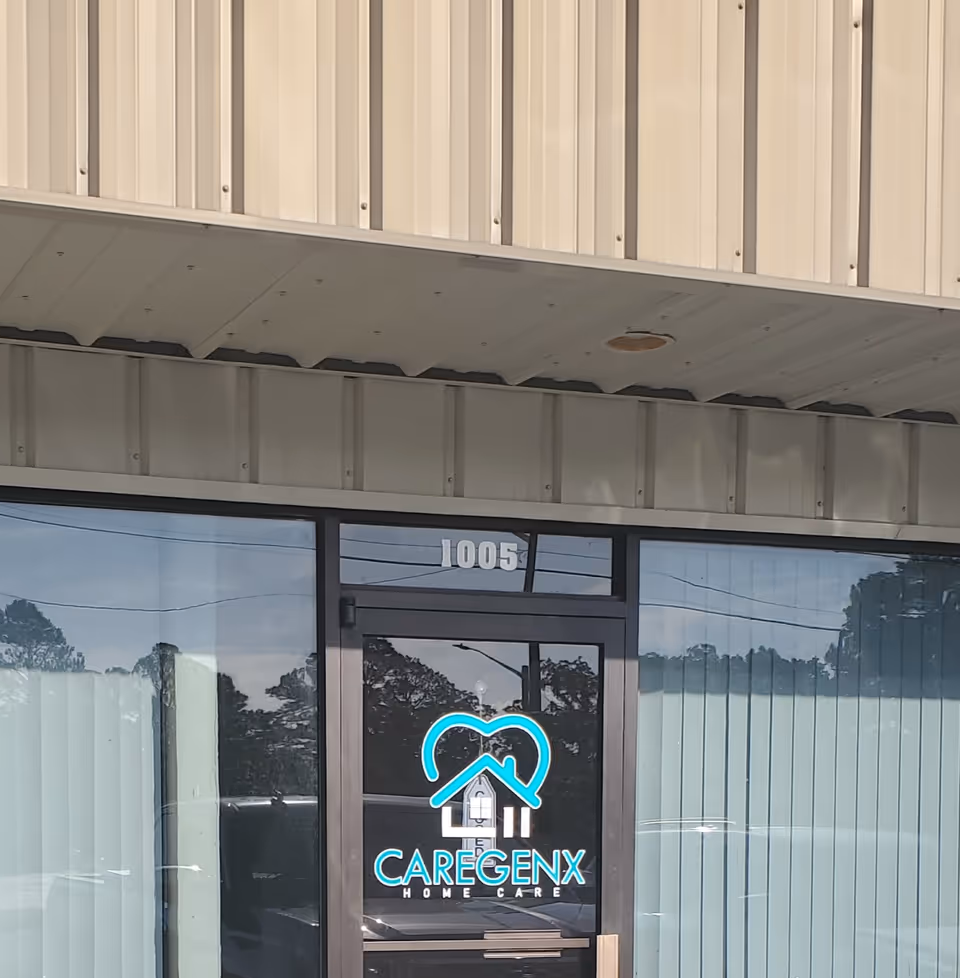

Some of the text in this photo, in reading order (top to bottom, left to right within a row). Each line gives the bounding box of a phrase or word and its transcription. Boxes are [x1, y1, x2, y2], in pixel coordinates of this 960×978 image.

[441, 539, 519, 571] 1005
[374, 849, 586, 886] CAREGENX
[402, 886, 561, 898] HOME CARE
